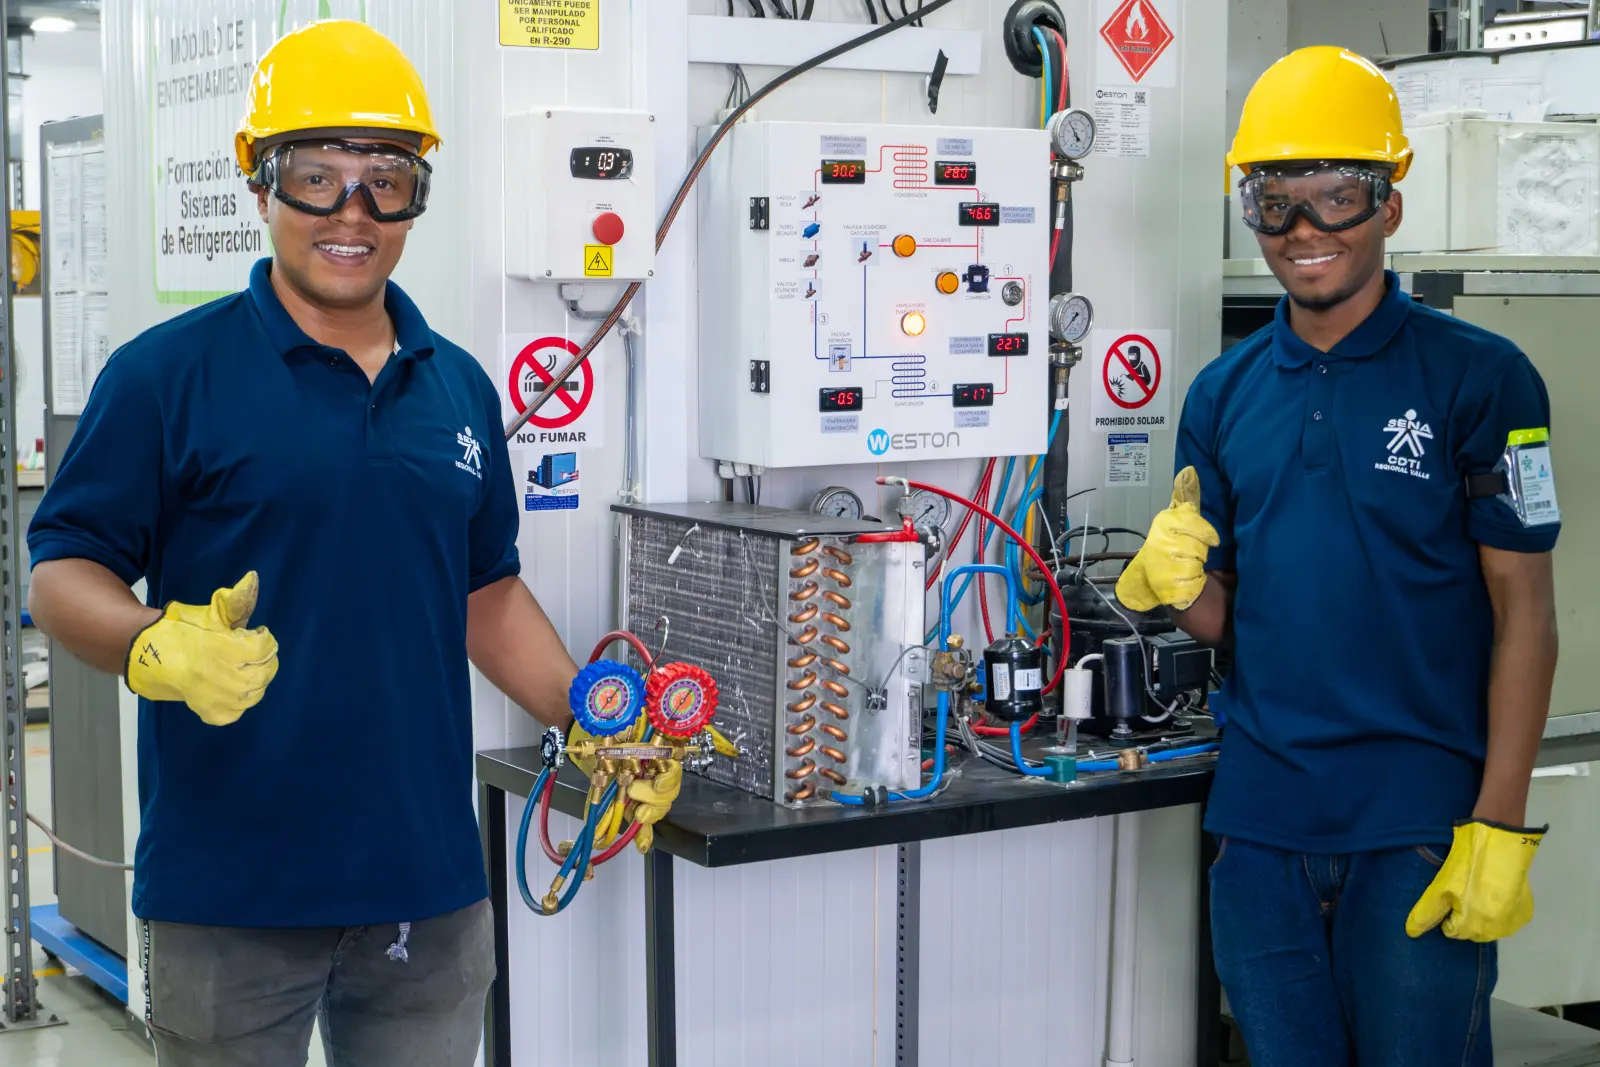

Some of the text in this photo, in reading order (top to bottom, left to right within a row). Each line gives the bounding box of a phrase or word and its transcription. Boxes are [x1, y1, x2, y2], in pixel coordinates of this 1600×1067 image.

[564, 0, 591, 9] PUEDE
[532, 8, 585, 17] MANIPULADO
[538, 17, 580, 26] PERSONAL
[526, 26, 574, 35] CALIFICADO
[170, 20, 243, 65] MÓDULO DE
[543, 36, 570, 45] R-290
[157, 61, 256, 108] ENTRENAMIENT
[1096, 90, 1127, 98] WESTON
[167, 150, 230, 185] Formación
[832, 164, 857, 178] 30.2
[944, 166, 968, 178] 28.0
[181, 190, 236, 219] Sistemas
[968, 207, 991, 220] 46.6
[162, 221, 260, 261] de Refrigeración
[1096, 416, 1165, 426] PROHIBIDO SOLDAR
[1388, 418, 1431, 434] SENA
[517, 432, 586, 443] NO FUMAR
[867, 429, 960, 455] WESTON
[1388, 455, 1421, 470] CDTI
[1374, 462, 1430, 479] REGIONAL VALLE
